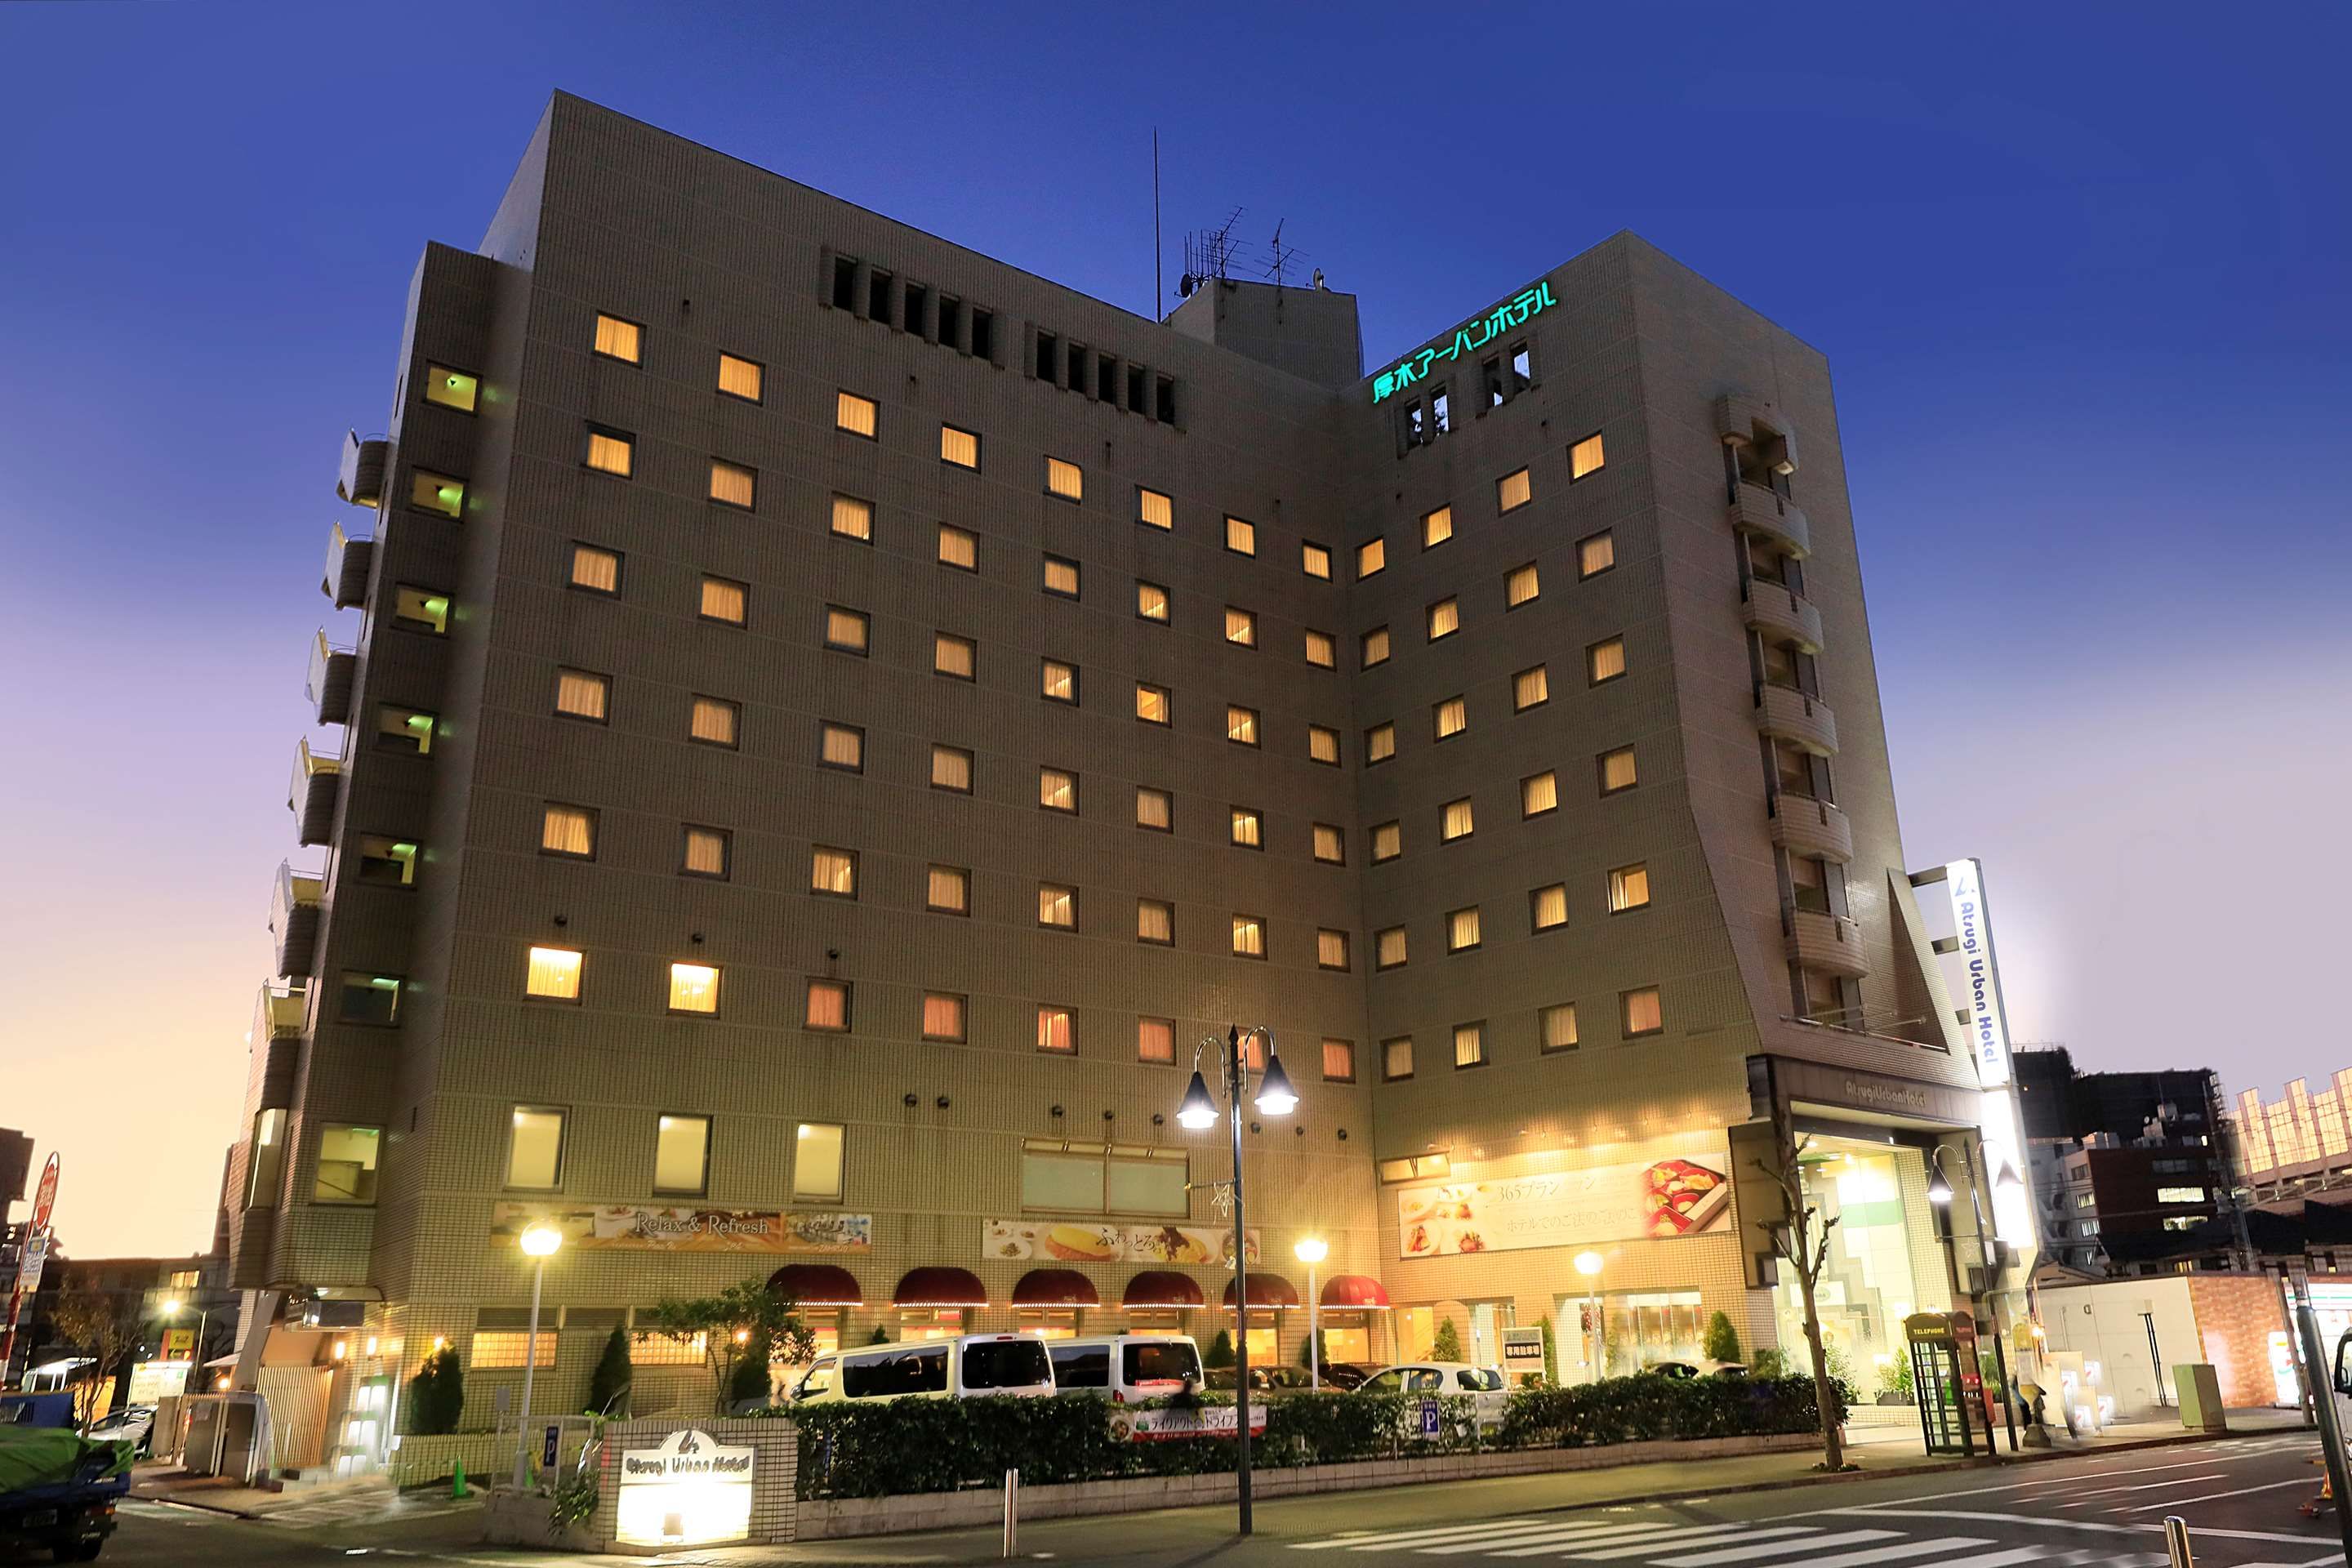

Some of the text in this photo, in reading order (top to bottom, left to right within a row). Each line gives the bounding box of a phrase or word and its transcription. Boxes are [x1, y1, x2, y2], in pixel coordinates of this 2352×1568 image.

[1373, 280, 1557, 404] 厚木アーバンホテル
[1960, 901, 1998, 1063] Atsugi Urban Hotel
[635, 1212, 769, 1240] Relax & Refresh
[1425, 1410, 1437, 1430] P
[546, 1439, 555, 1463] P
[672, 1456, 710, 1474] Urban
